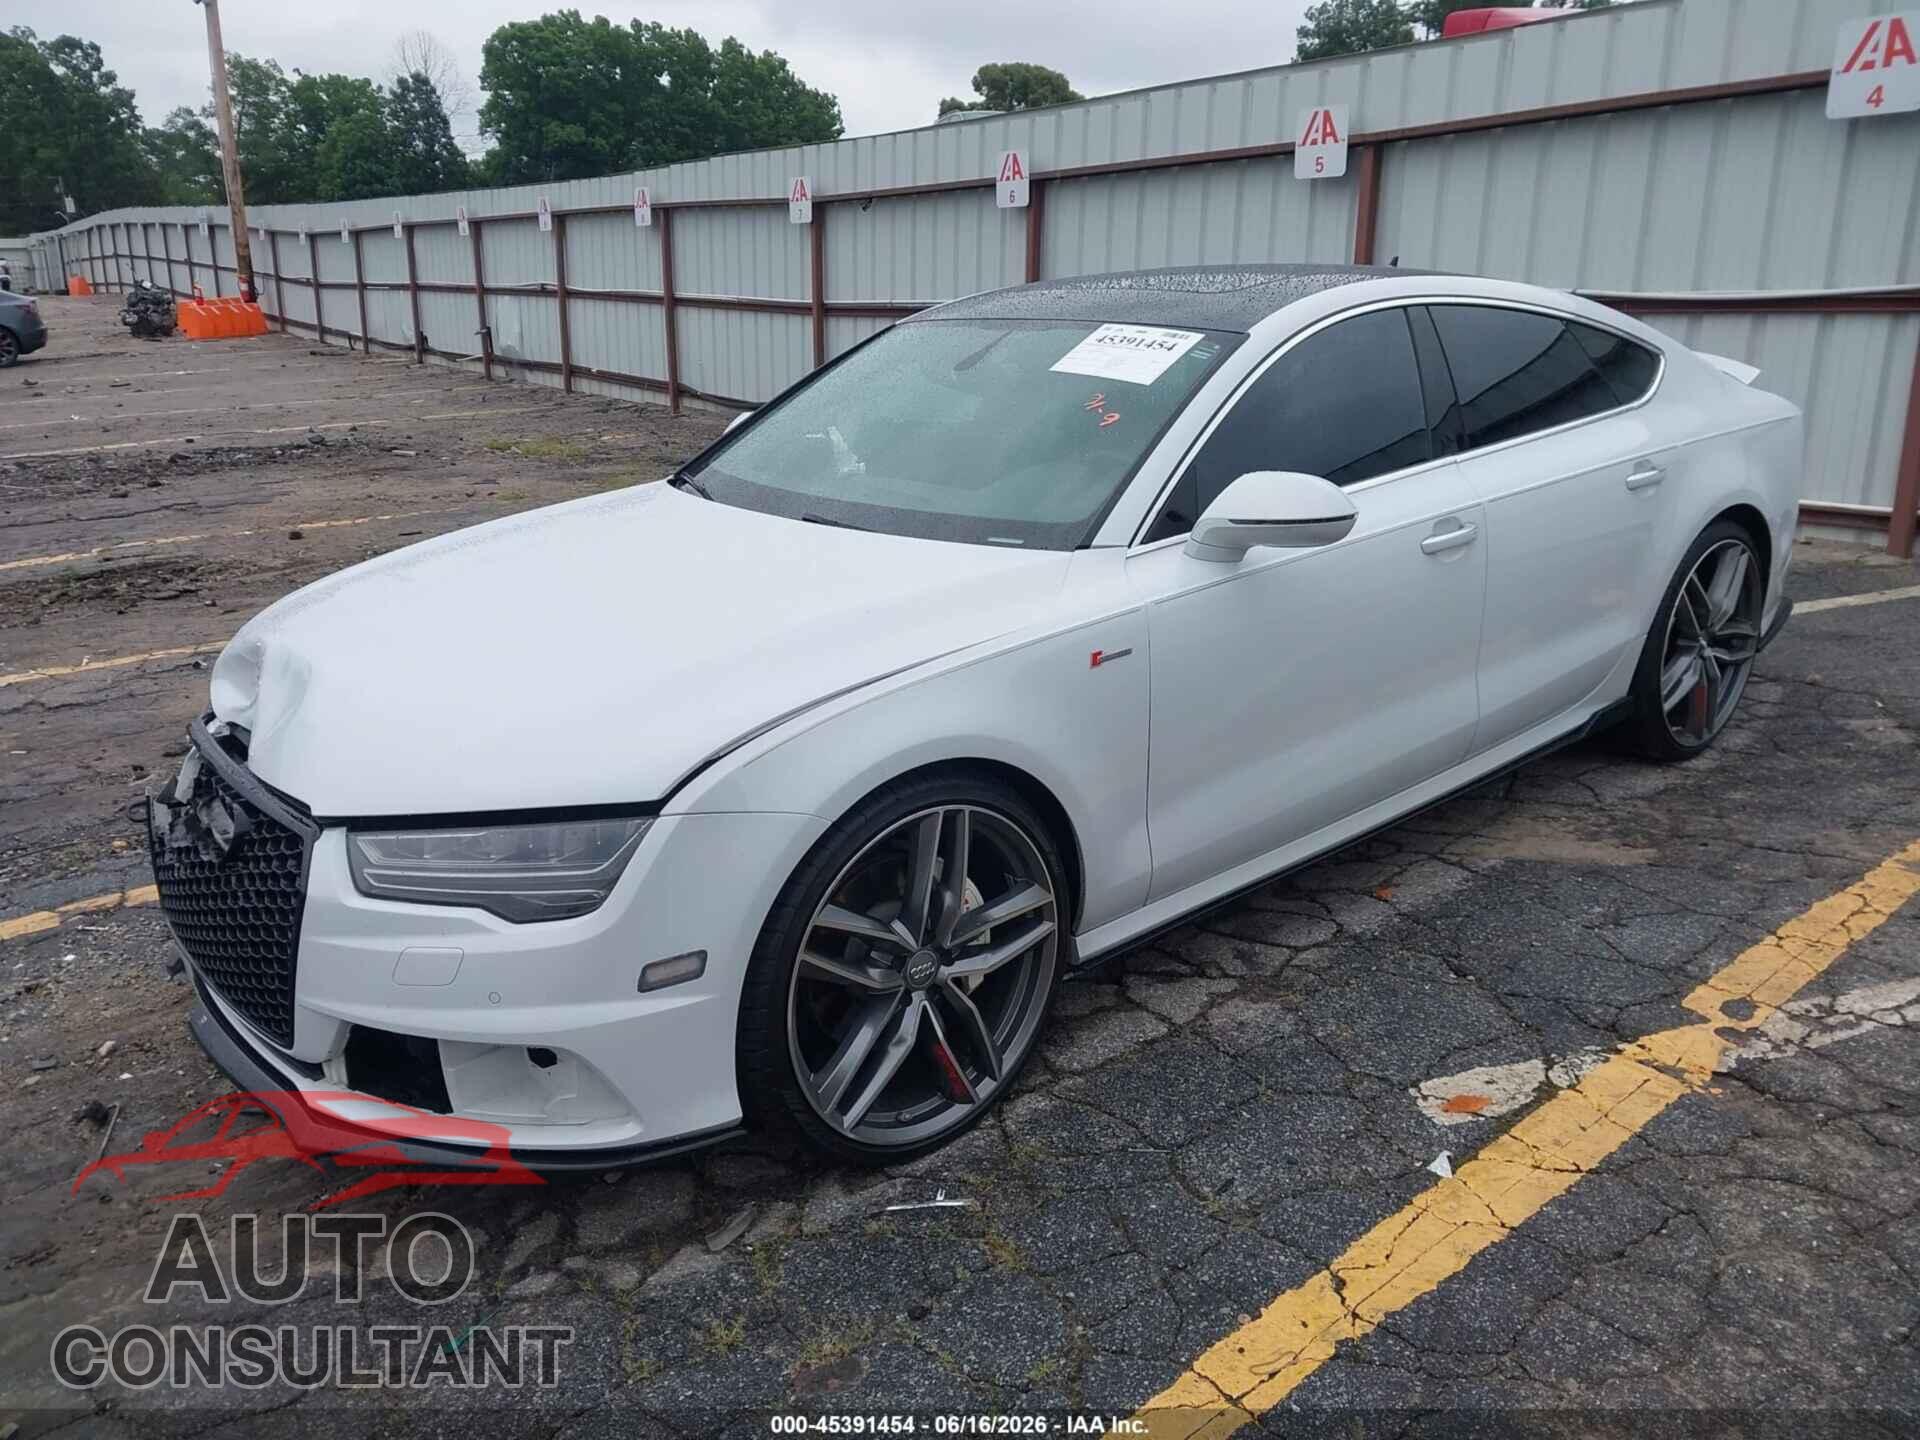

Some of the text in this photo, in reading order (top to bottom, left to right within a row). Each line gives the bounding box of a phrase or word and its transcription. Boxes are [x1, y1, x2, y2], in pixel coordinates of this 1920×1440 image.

[1866, 84, 1885, 108] 4
[1315, 156, 1325, 173] 5
[1009, 190, 1016, 203] 6
[1096, 334, 1178, 352] 45391454
